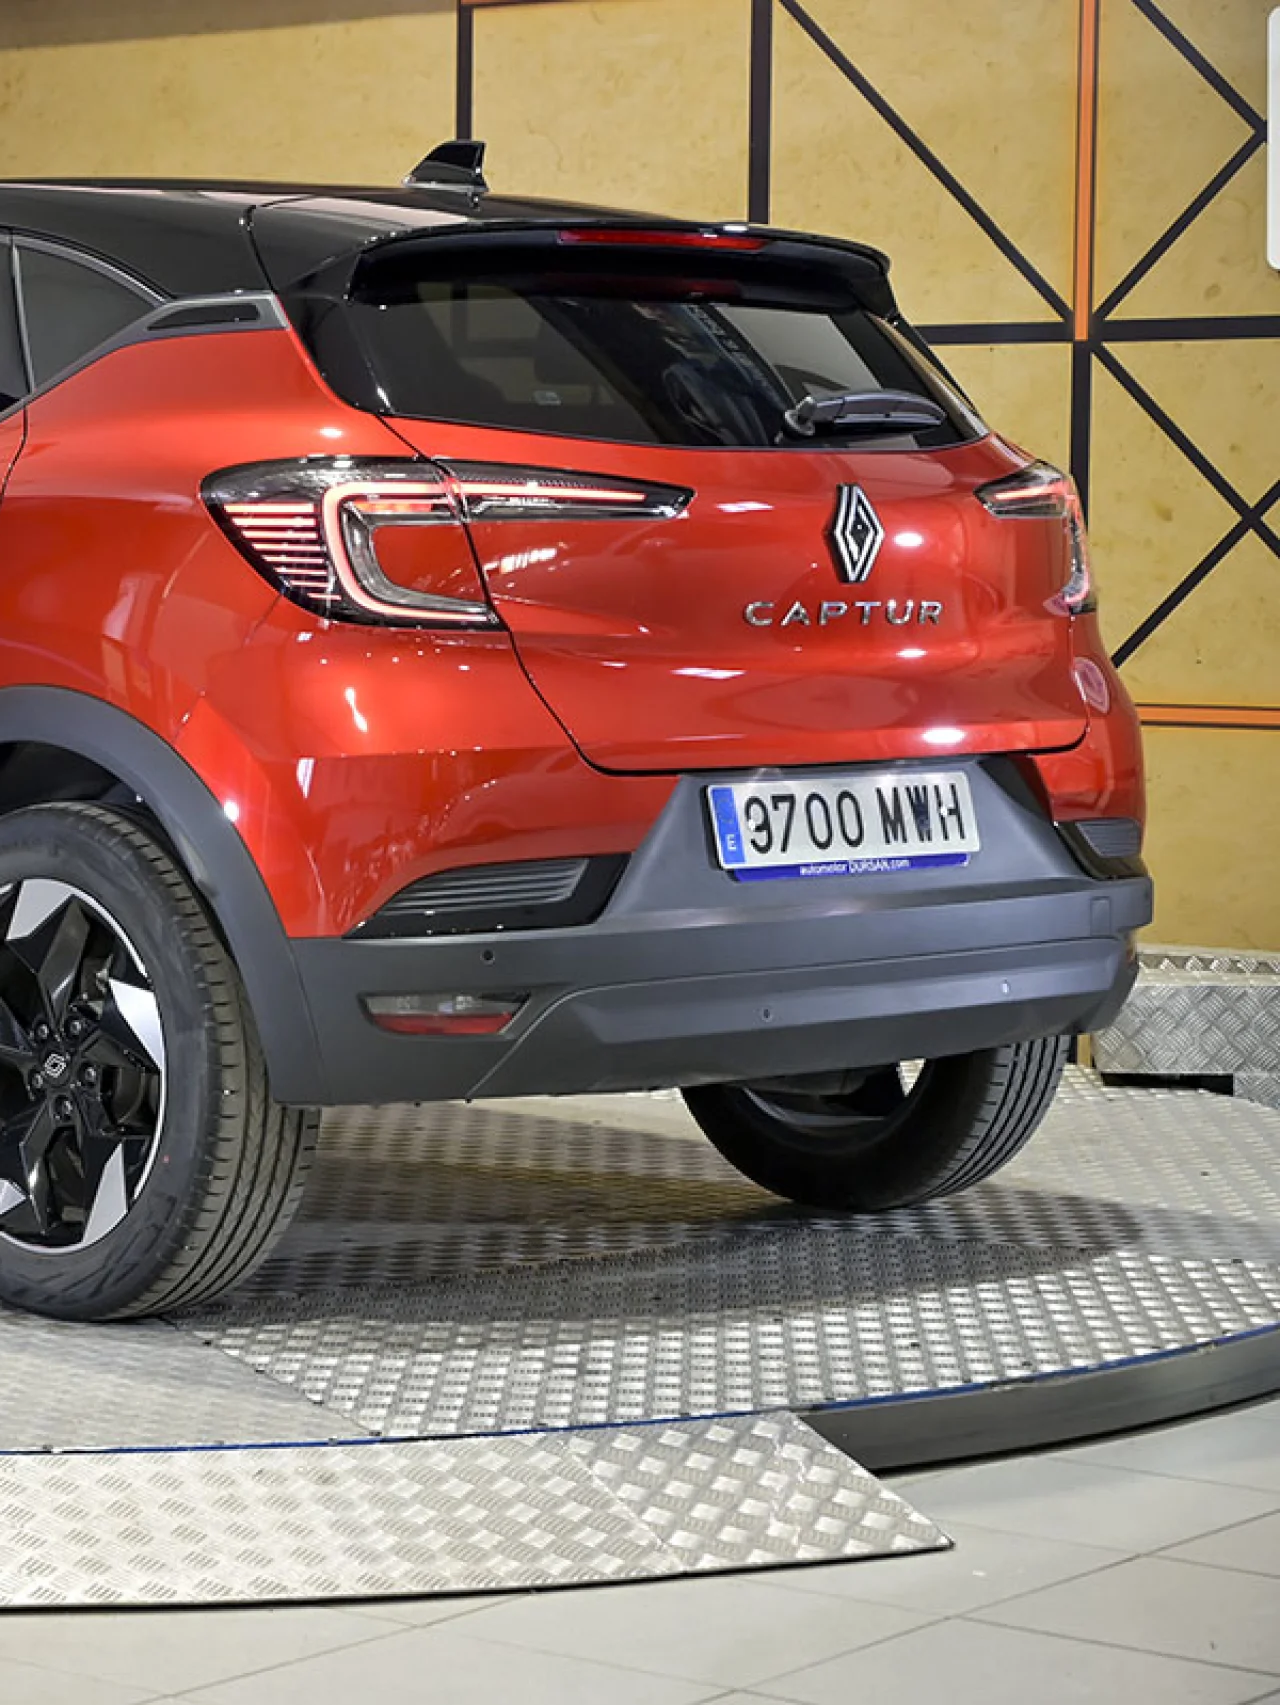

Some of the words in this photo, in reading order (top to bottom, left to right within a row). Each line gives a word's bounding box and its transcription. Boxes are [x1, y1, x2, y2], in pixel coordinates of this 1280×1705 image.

[744, 598, 944, 627] CAPTUR
[744, 789, 864, 854] 9700
[876, 782, 965, 845] MWH
[725, 834, 737, 851] E
[800, 863, 847, 876] automotor
